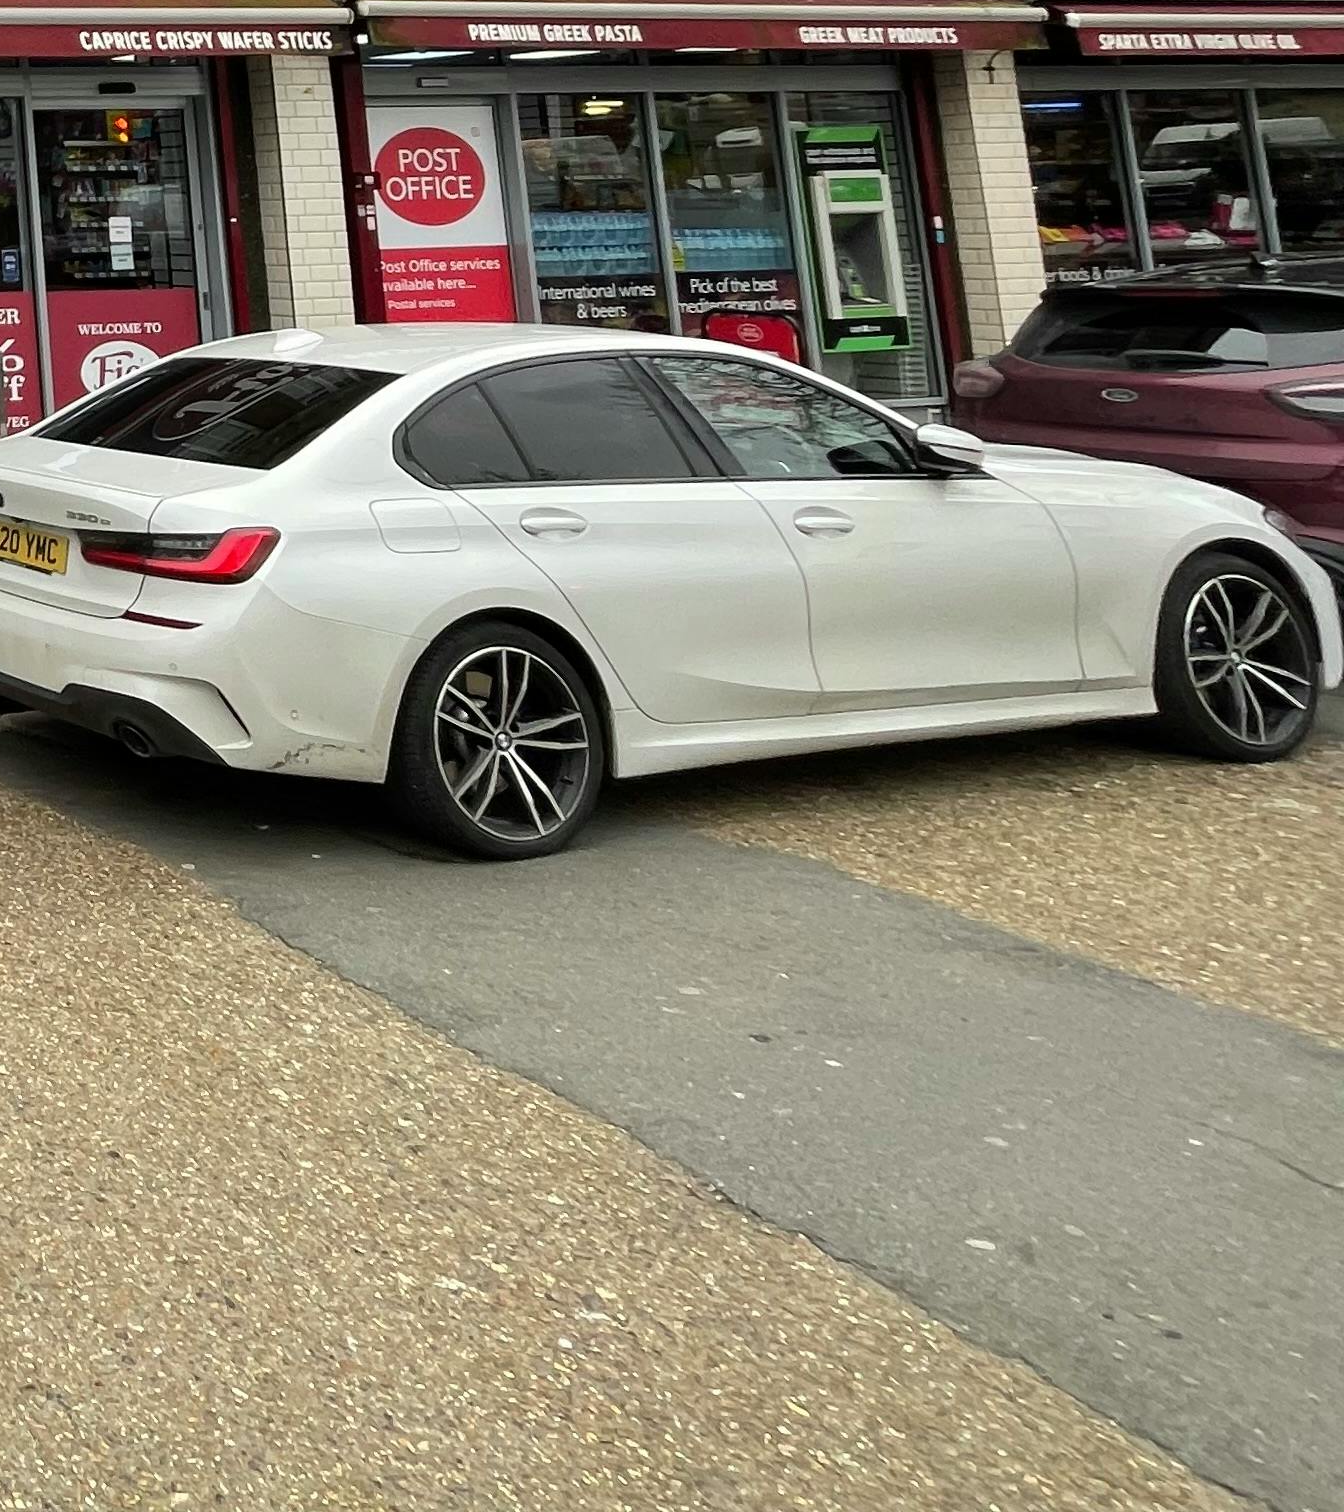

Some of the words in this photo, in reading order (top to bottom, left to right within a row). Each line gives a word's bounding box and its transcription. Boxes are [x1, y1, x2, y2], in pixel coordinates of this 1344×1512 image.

[79, 30, 153, 51] CAPRICE
[155, 30, 214, 50] CRISPY
[217, 30, 275, 50] WAFER
[277, 30, 333, 50] STICKS
[467, 23, 542, 42] PREMIUM
[543, 24, 593, 43] GREEK
[594, 25, 644, 43] PASTA
[798, 26, 846, 44] GREEK
[846, 27, 885, 44] MEAT
[887, 27, 959, 44] PRODUCTS
[1150, 33, 1193, 50] EXTRA
[398, 147, 461, 173] POST
[385, 175, 475, 201] OFFICE
[408, 258, 447, 273] Office
[449, 257, 501, 272] services
[537, 282, 617, 301] International
[618, 281, 657, 297] wines
[689, 277, 715, 294] Pick
[716, 276, 729, 293] of
[730, 276, 751, 293] the
[751, 276, 779, 292] best
[576, 303, 589, 319] &
[590, 302, 628, 319] beers
[76, 322, 143, 336] WELCOME
[143, 321, 162, 334] TO
[25, 533, 59, 564] YMC
